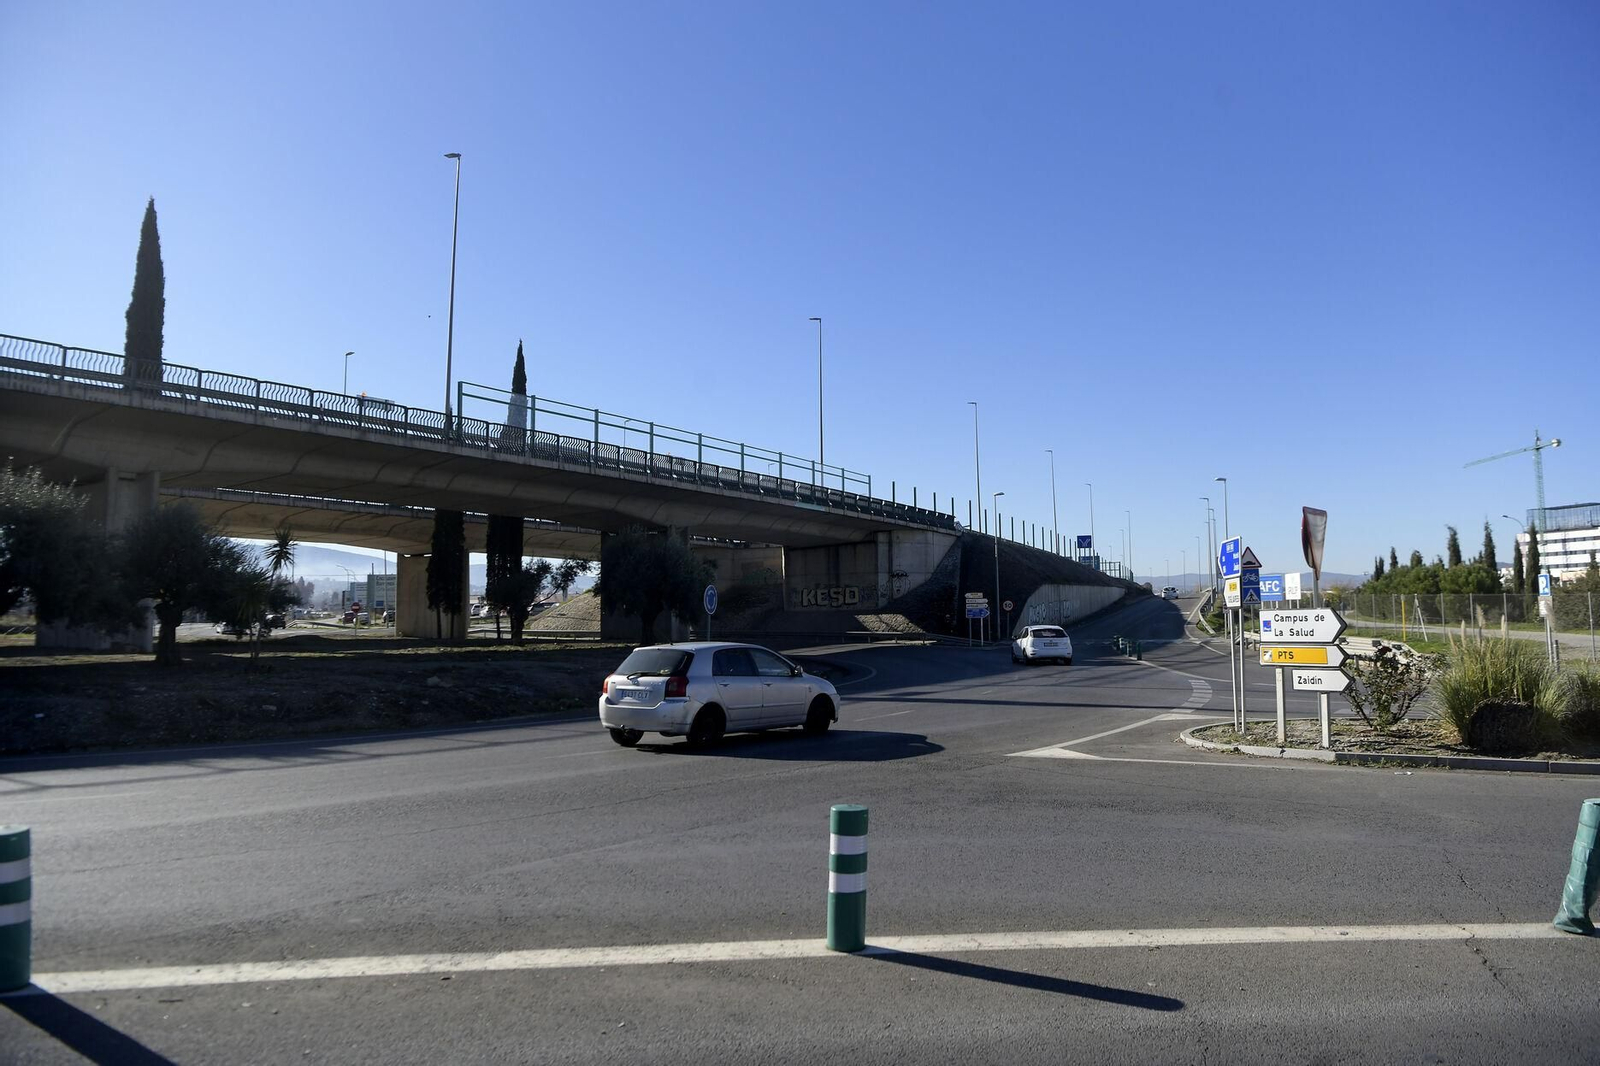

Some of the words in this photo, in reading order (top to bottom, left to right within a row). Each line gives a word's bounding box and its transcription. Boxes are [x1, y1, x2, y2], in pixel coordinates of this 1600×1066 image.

[1273, 614, 1308, 624] Campus
[1314, 614, 1325, 622] de
[1274, 628, 1284, 636] La
[1289, 628, 1315, 637] Salud
[1277, 651, 1294, 660] PTS
